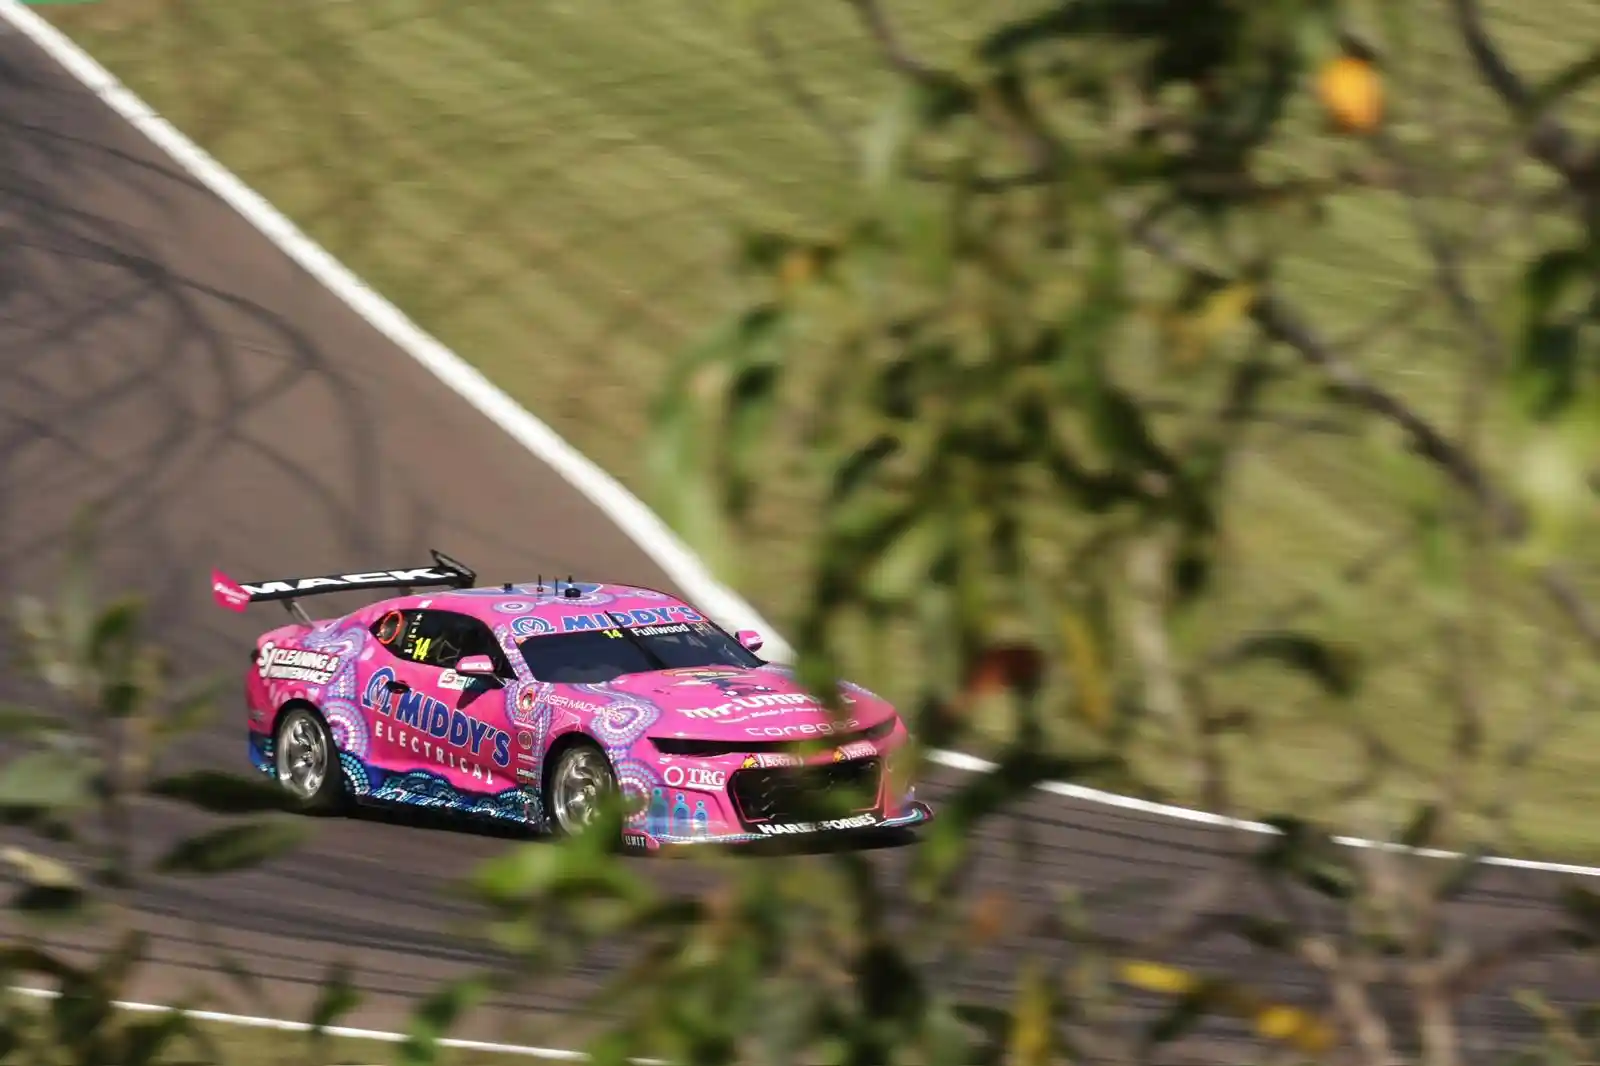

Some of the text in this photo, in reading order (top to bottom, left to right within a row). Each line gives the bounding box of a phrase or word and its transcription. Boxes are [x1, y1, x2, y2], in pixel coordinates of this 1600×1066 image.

[562, 605, 702, 632] MIDDY'S
[631, 622, 691, 636] Fullwood
[411, 637, 432, 661] 14
[394, 687, 512, 768] MIDDY'S
[375, 720, 494, 785] ELECTRICAL
[687, 767, 726, 787] TRG
